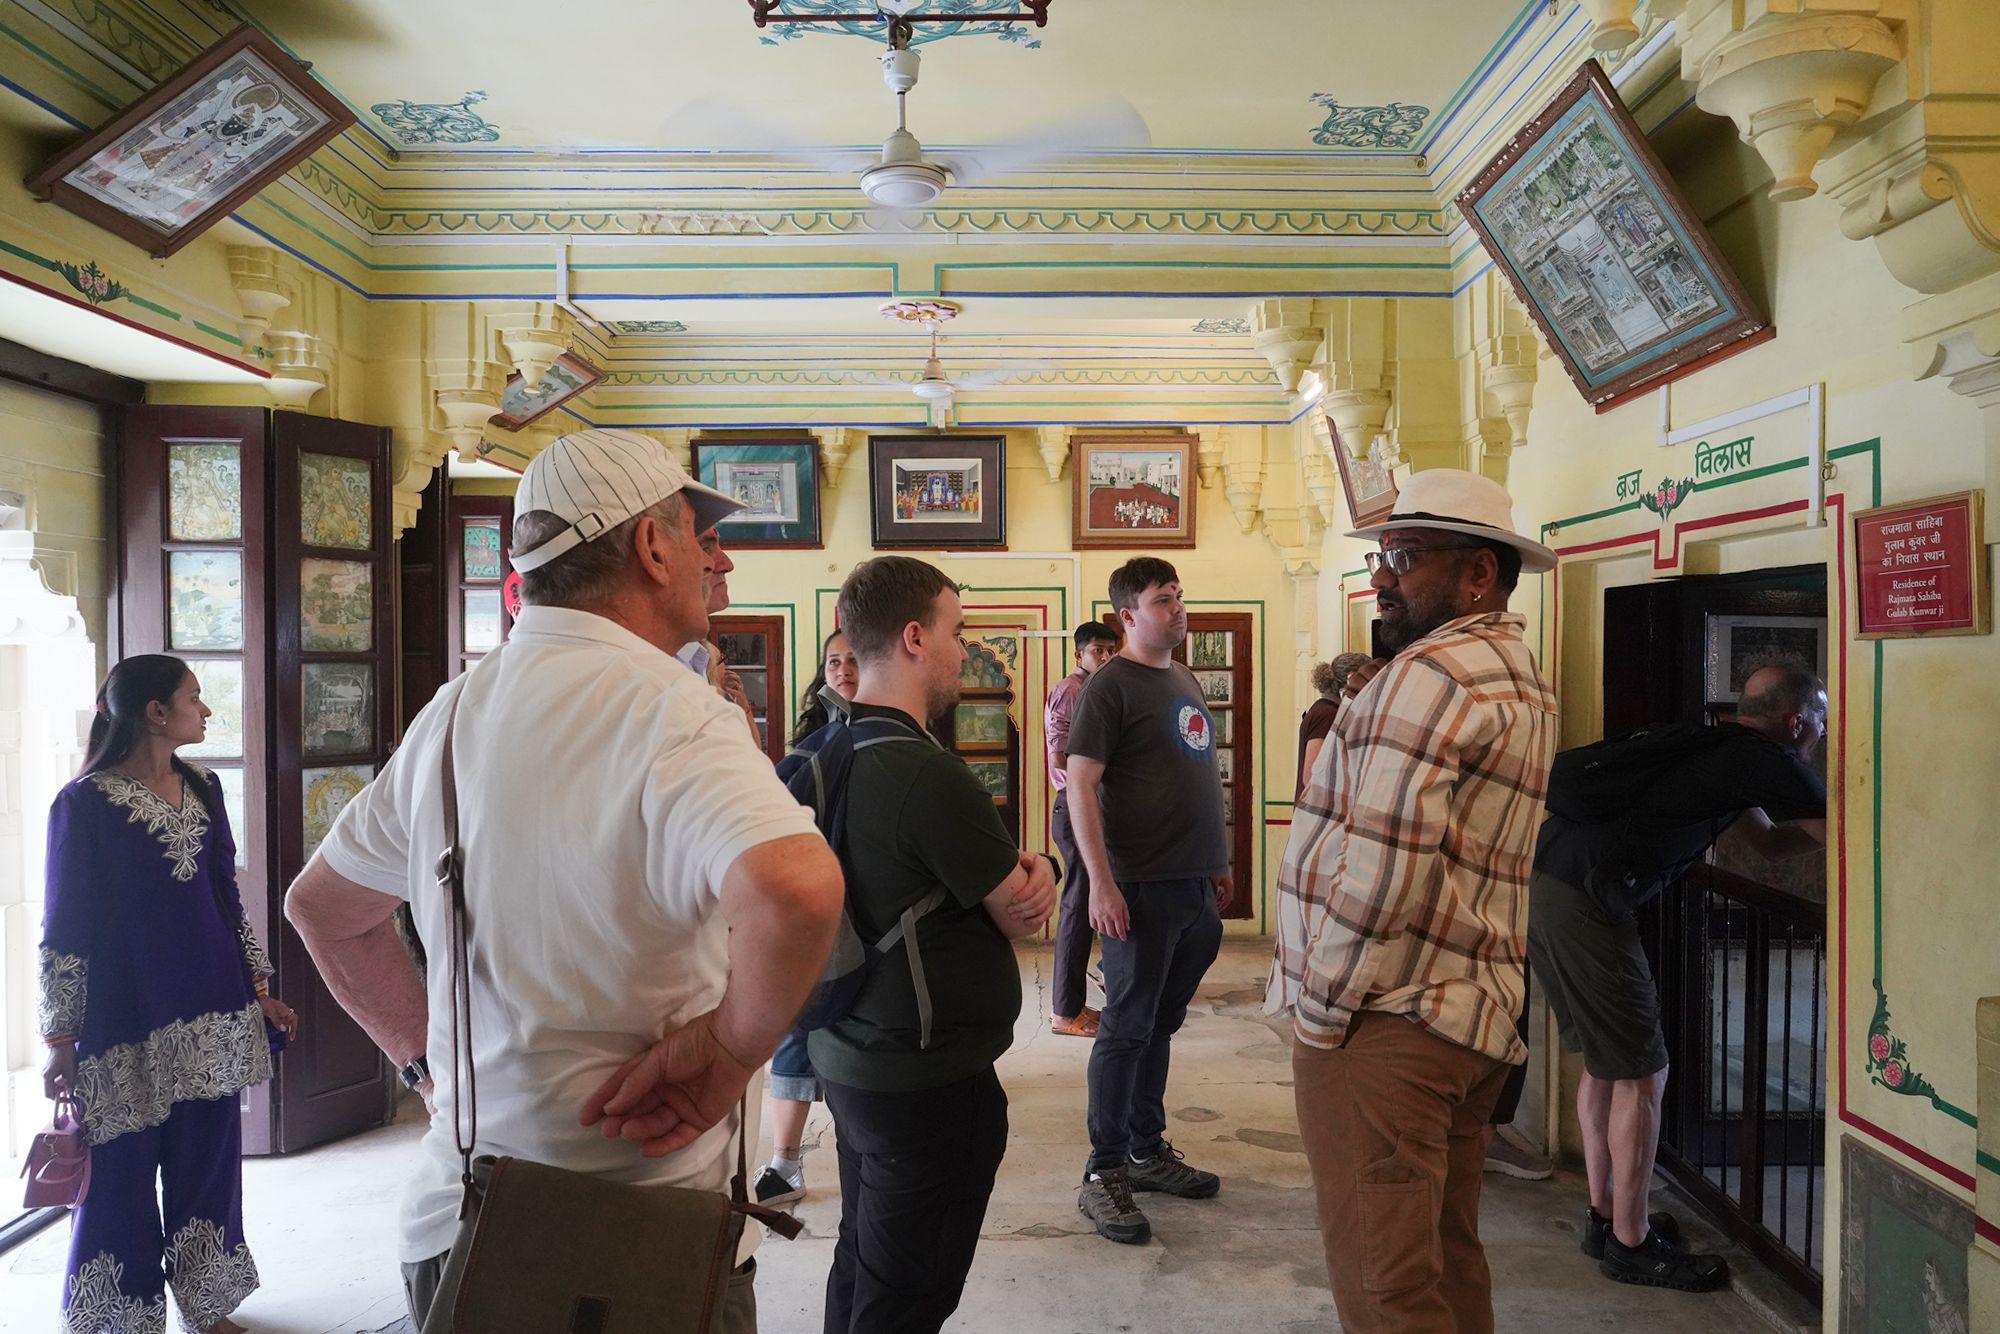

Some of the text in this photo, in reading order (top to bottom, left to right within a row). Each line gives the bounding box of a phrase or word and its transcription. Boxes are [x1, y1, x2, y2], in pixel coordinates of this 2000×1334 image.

[1695, 436, 1754, 478] विलास
[1881, 515, 1943, 535] राजमाता साहिबा
[1885, 539, 1905, 554] गुलाब
[1930, 532, 1940, 544] जी
[1882, 550, 1945, 567] का निवास स्थान
[1893, 576, 1936, 589] Residence of
[1888, 590, 1941, 605] Rajmata Sahiba
[1887, 605, 1944, 618] Gulab Kunwar ji
